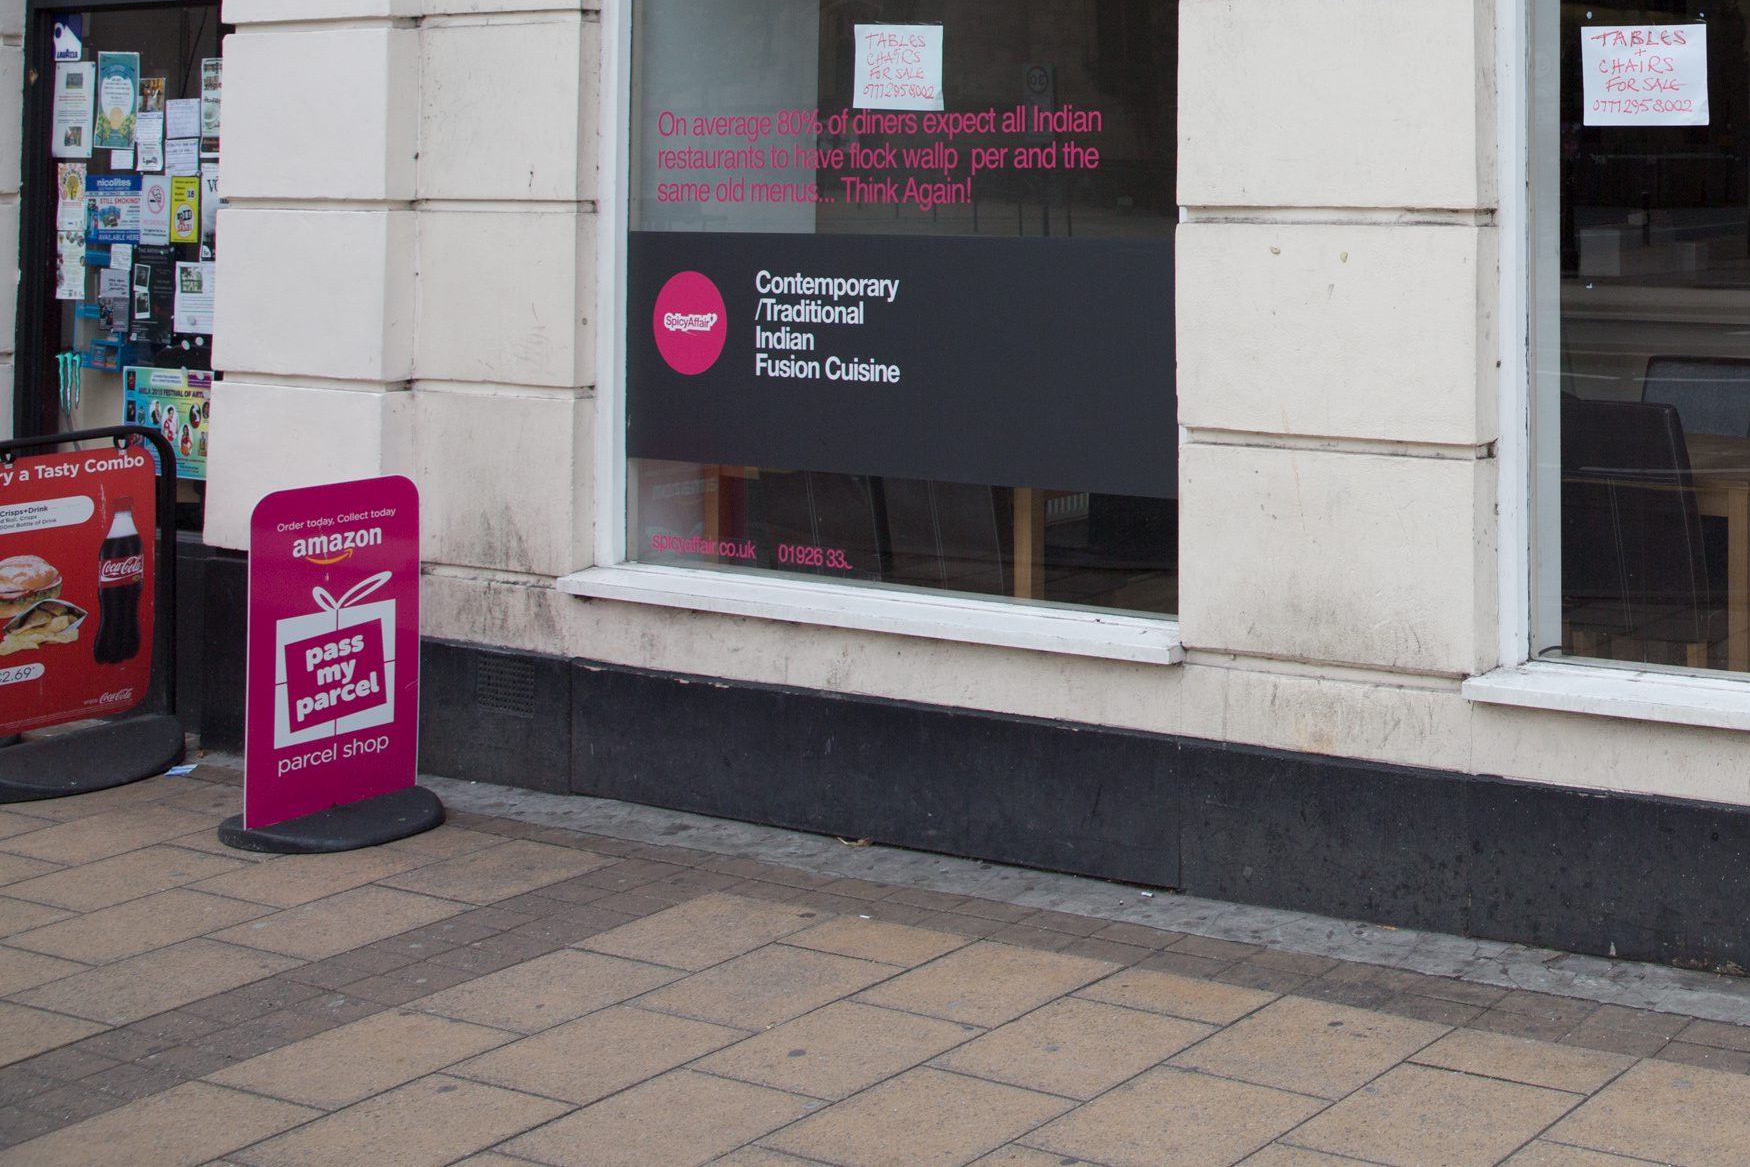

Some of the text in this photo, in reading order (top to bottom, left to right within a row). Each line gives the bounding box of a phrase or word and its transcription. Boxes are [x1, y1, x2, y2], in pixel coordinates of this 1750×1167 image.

[865, 32, 926, 50] TABLES
[1591, 30, 1687, 47] TABLES
[866, 48, 921, 66] CHAIRS
[1599, 56, 1675, 75] CHAIRS
[869, 66, 924, 80] FOR SALE
[1606, 76, 1689, 92] FOR SALE
[657, 104, 1102, 143] On average 80% of diners expect all Indian
[657, 145, 765, 170] restaurants
[770, 145, 789, 170] to
[793, 143, 844, 170] have
[850, 142, 897, 169] flock
[1013, 141, 1056, 169] and
[1063, 141, 1099, 169] the
[97, 178, 131, 186] nicolites
[657, 182, 710, 203] same
[715, 177, 744, 203] old
[841, 177, 899, 203] Think
[902, 177, 972, 211] Again!
[755, 269, 900, 303] Contemporary
[754, 298, 864, 324] /Traditional
[755, 325, 815, 351] Indian
[755, 352, 900, 383] Fusion Cuisine
[19, 470, 30, 482] a
[34, 462, 80, 478] Tasty
[84, 456, 145, 473] Combo
[277, 507, 396, 532] Order today, Collect today
[292, 526, 383, 558] amazon
[652, 534, 756, 560] spicyaffair.co.uk
[778, 544, 823, 566] 01926
[305, 634, 365, 672] pass
[316, 659, 356, 686] my
[296, 671, 380, 722] parcel
[278, 735, 389, 777] parcel shop
